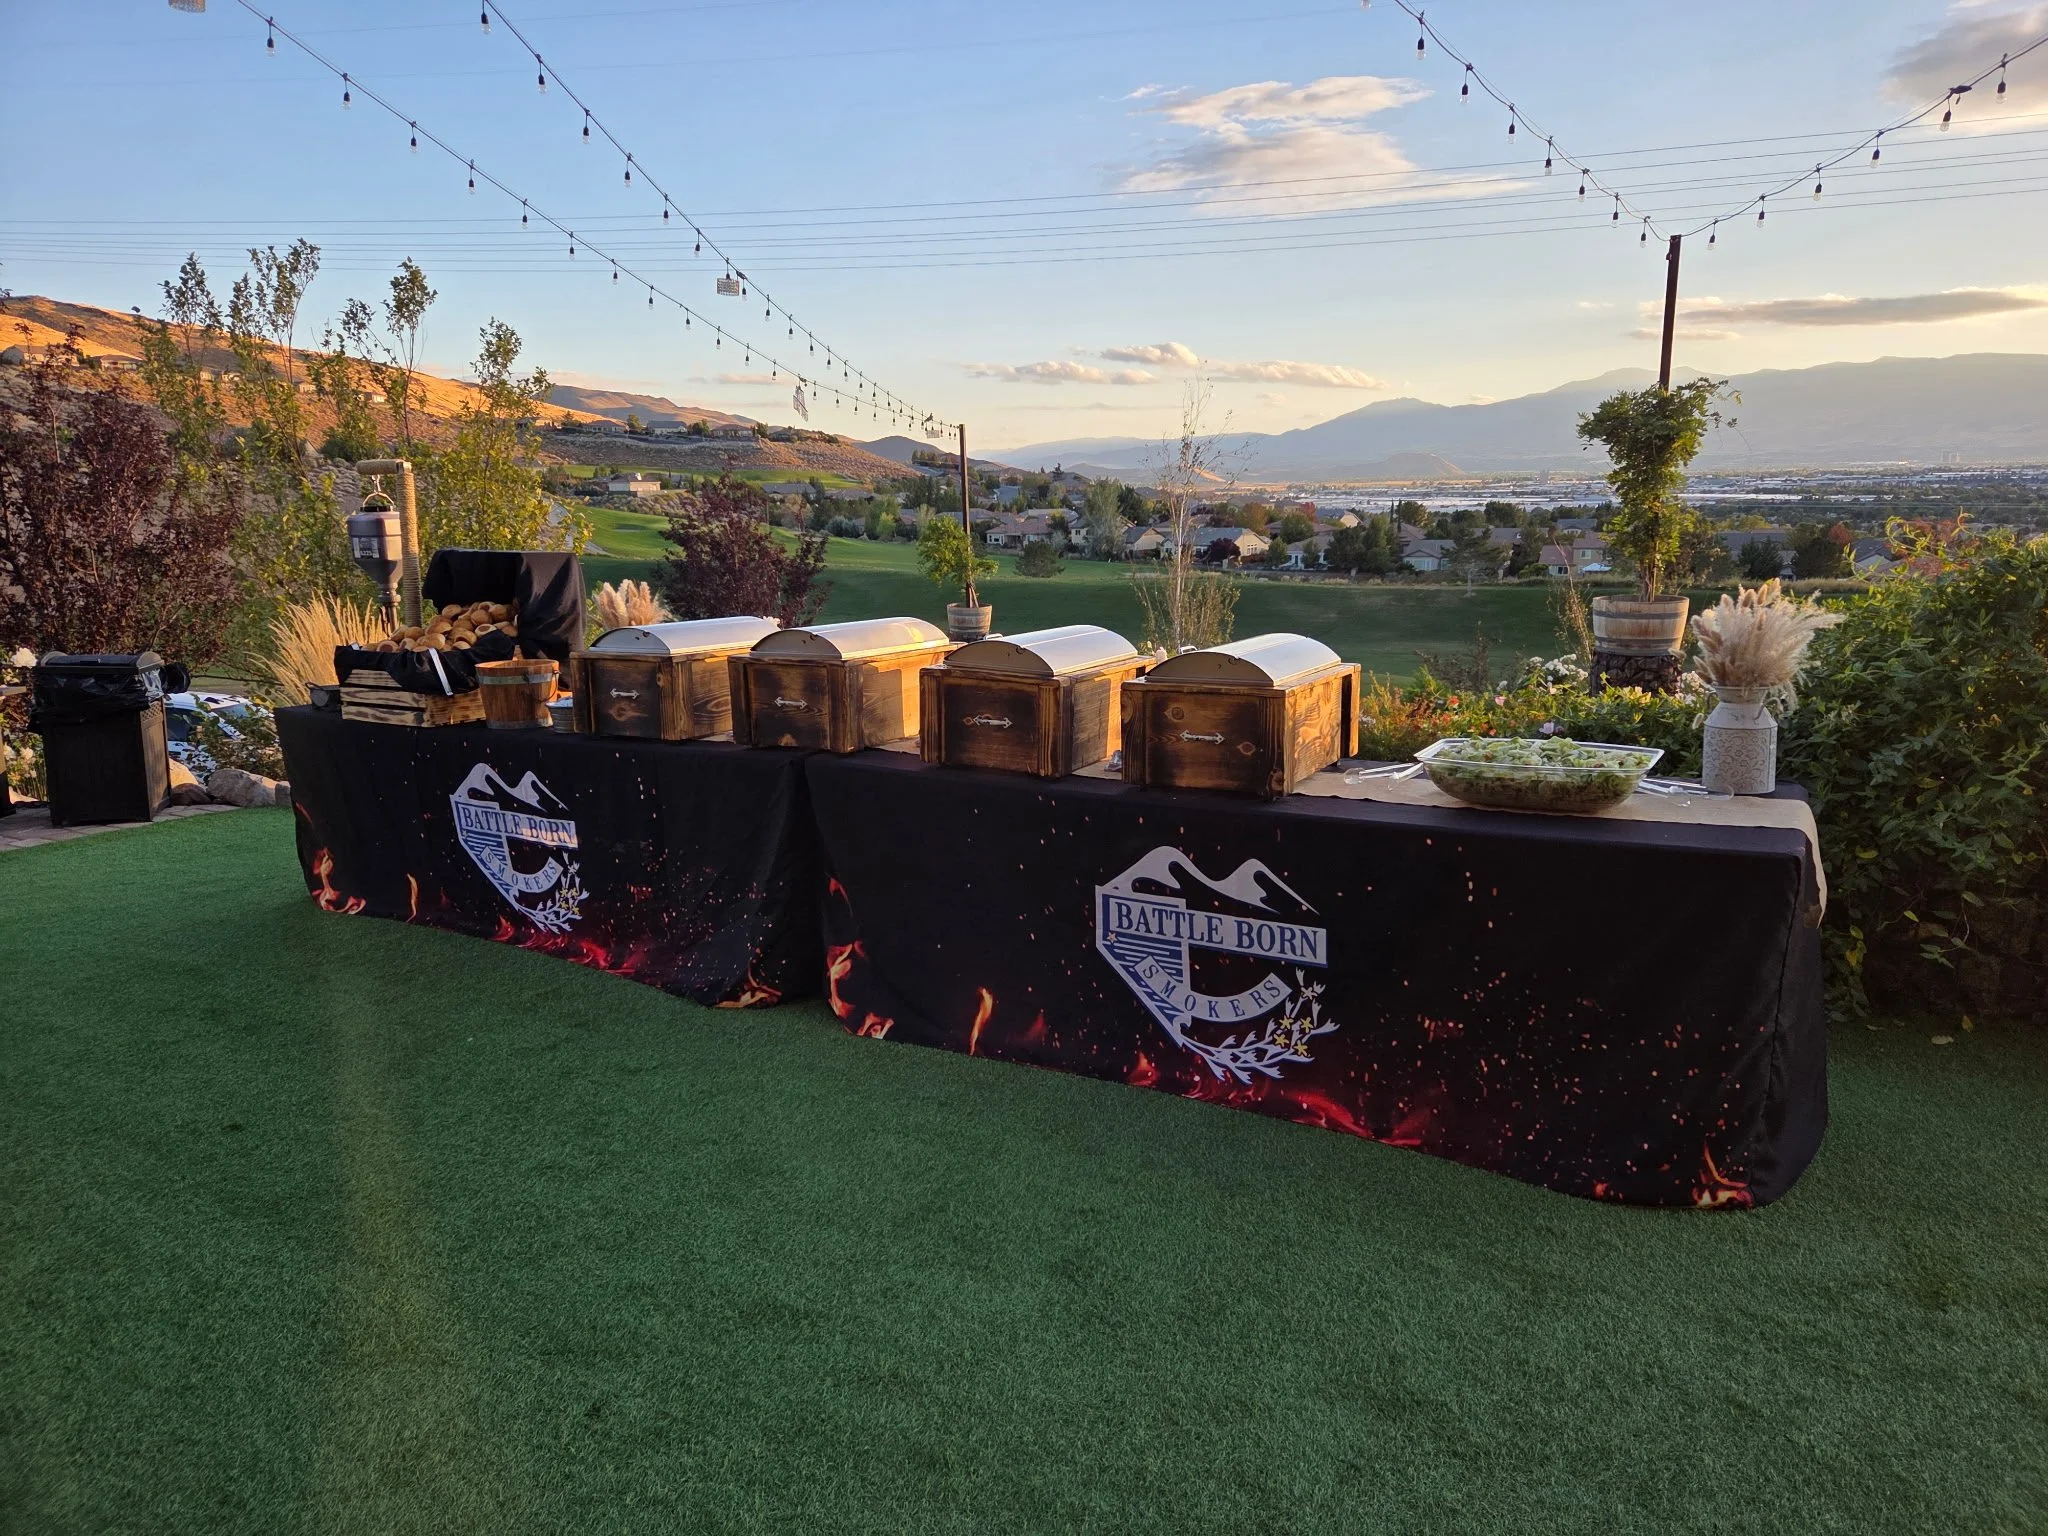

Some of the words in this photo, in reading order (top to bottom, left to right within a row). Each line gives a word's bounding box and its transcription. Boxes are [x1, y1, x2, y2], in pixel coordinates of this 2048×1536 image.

[461, 807, 524, 836] BATTLE
[527, 818, 574, 845] BORN
[485, 853, 557, 893] SMOKERS
[1115, 902, 1224, 945] BATTLE
[1234, 919, 1319, 960] BORN
[1142, 963, 1281, 1019] SMOKERS
